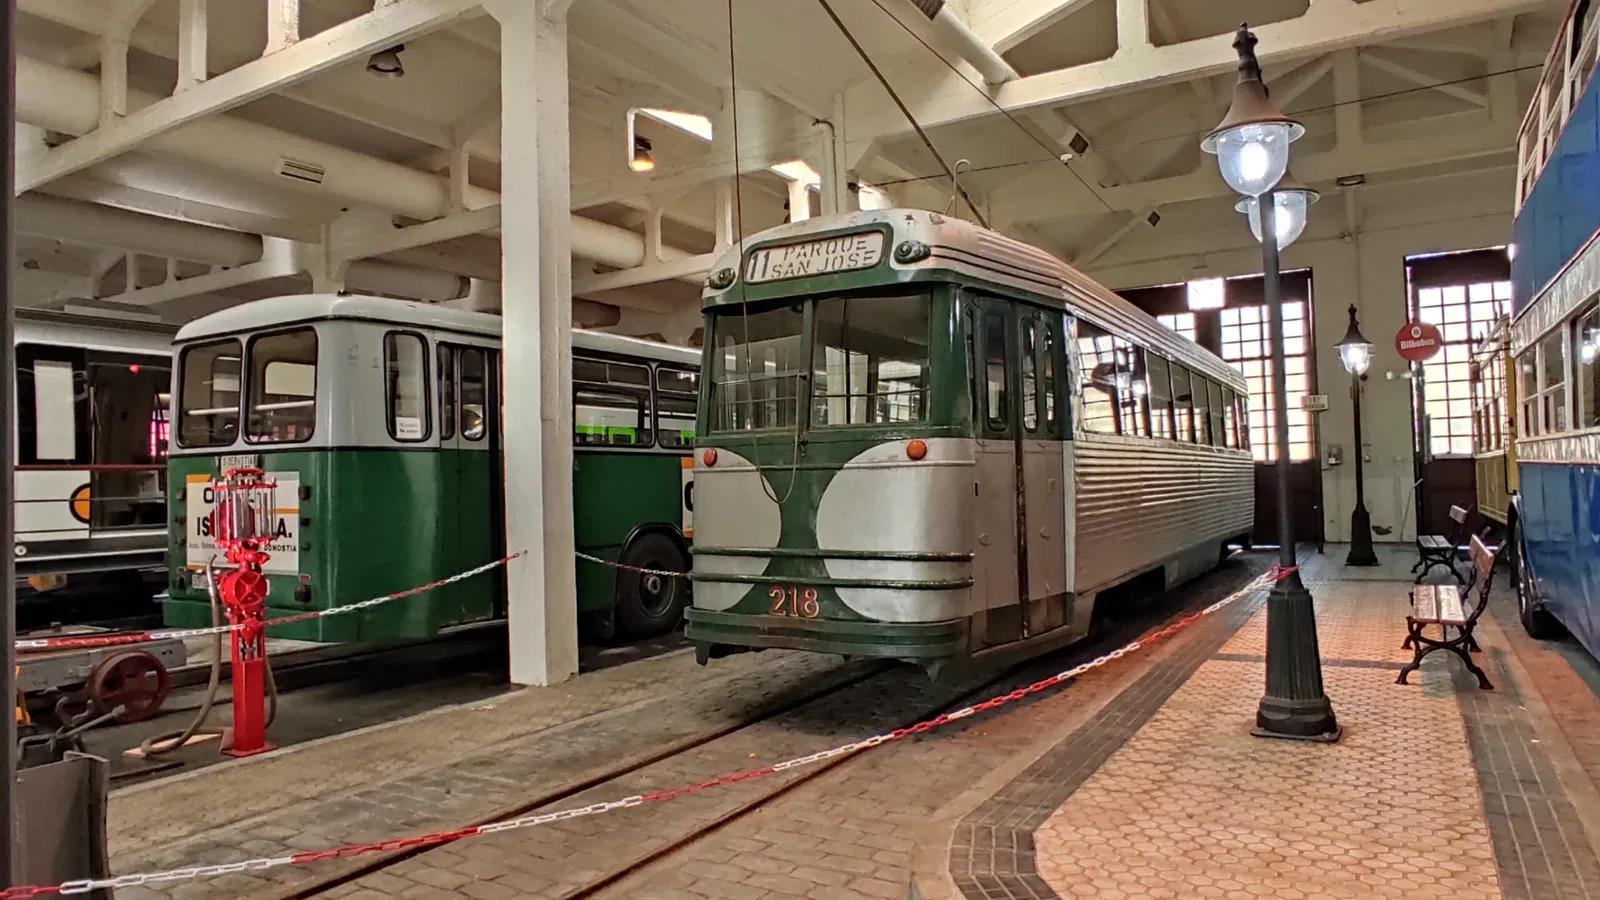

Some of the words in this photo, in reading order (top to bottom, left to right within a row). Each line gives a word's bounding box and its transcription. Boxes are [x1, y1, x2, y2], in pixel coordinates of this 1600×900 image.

[750, 250, 772, 280] 11
[771, 259, 810, 279] SAN
[817, 249, 876, 273] JOSE
[768, 585, 819, 618] 218
